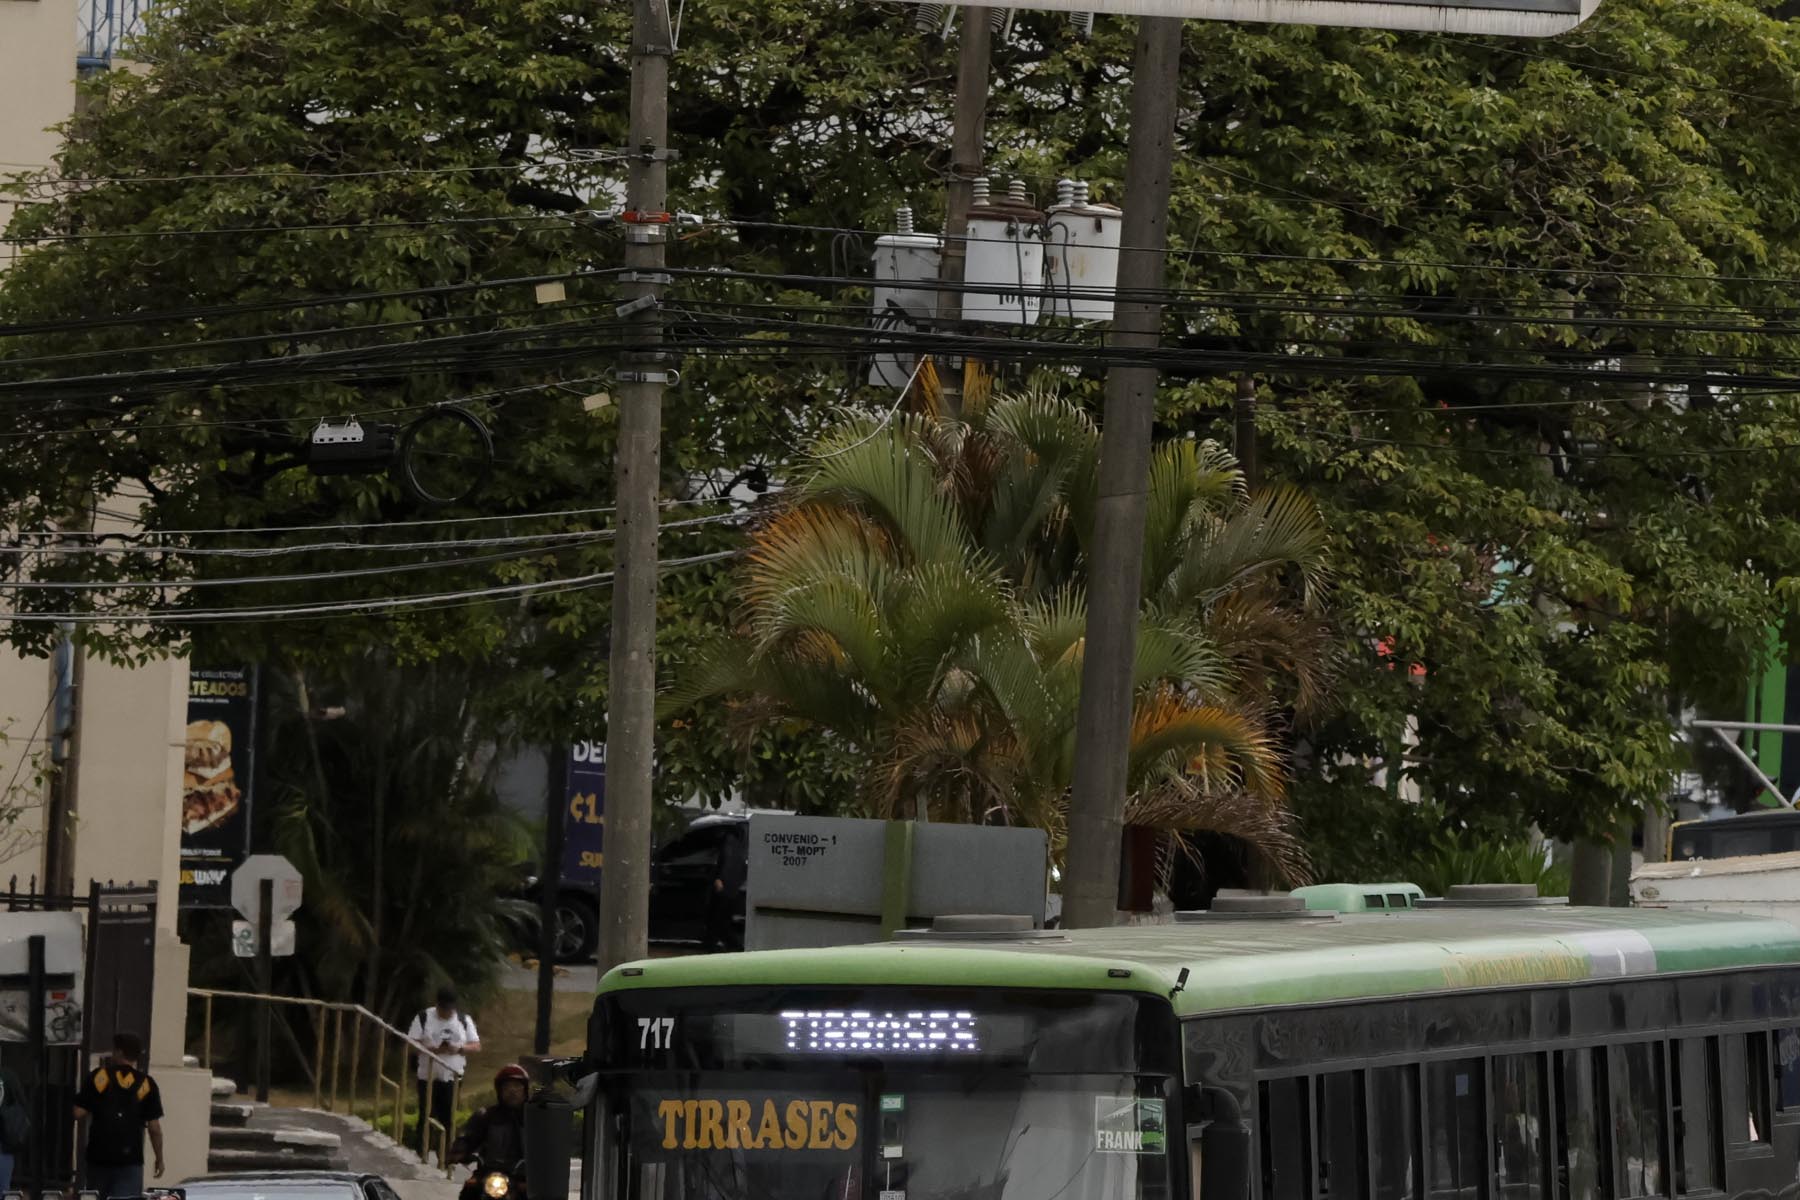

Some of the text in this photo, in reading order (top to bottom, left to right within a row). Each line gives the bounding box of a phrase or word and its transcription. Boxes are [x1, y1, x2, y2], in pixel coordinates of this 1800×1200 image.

[188, 680, 247, 696] TEADOS
[573, 739, 607, 763] DE
[764, 833, 818, 845] CONVENIO
[797, 846, 826, 856] MOPT
[783, 856, 807, 866] 2007
[637, 1018, 675, 1050] 717
[657, 1099, 858, 1151] TIRRASES
[1097, 1130, 1144, 1150] FRANK
